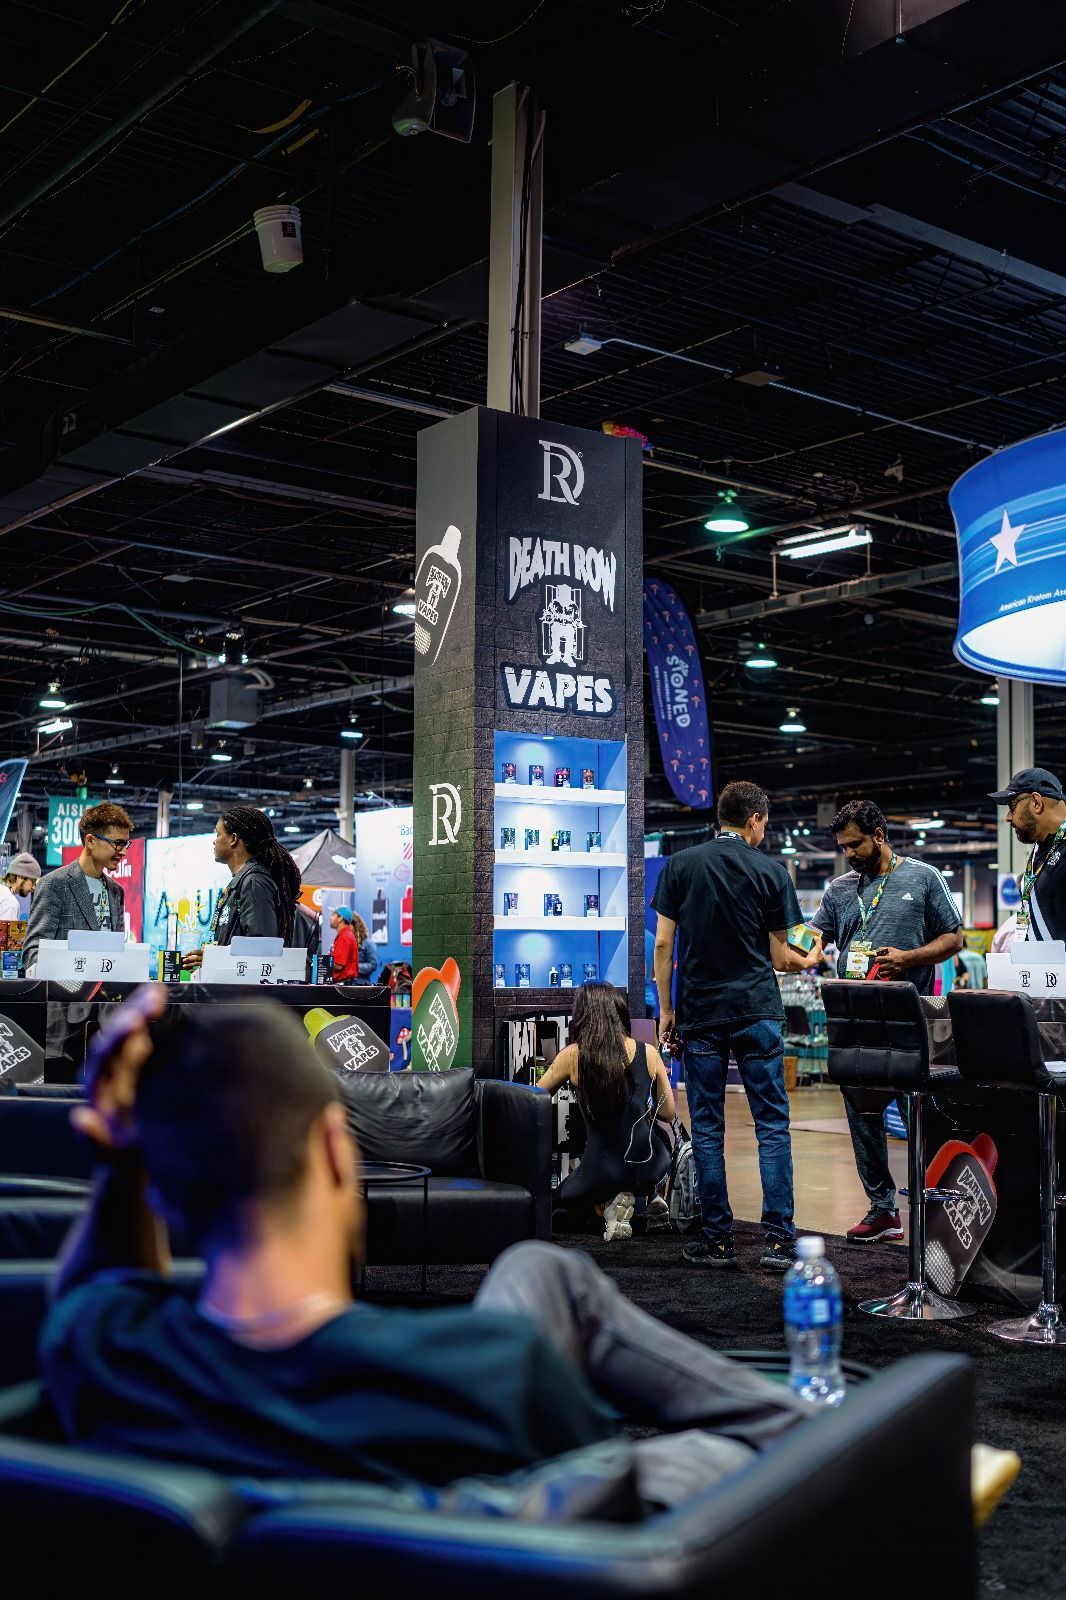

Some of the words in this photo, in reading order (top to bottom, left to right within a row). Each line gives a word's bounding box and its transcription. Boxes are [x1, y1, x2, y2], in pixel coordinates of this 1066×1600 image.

[509, 537, 570, 600] DEATH
[574, 546, 616, 612] ROW
[1000, 599, 1026, 612] American
[1027, 592, 1052, 603] Kratom
[505, 666, 613, 713] VAPES
[666, 655, 691, 728] STONED
[0, 1048, 31, 1074] APES
[344, 1045, 379, 1071] VAPES
